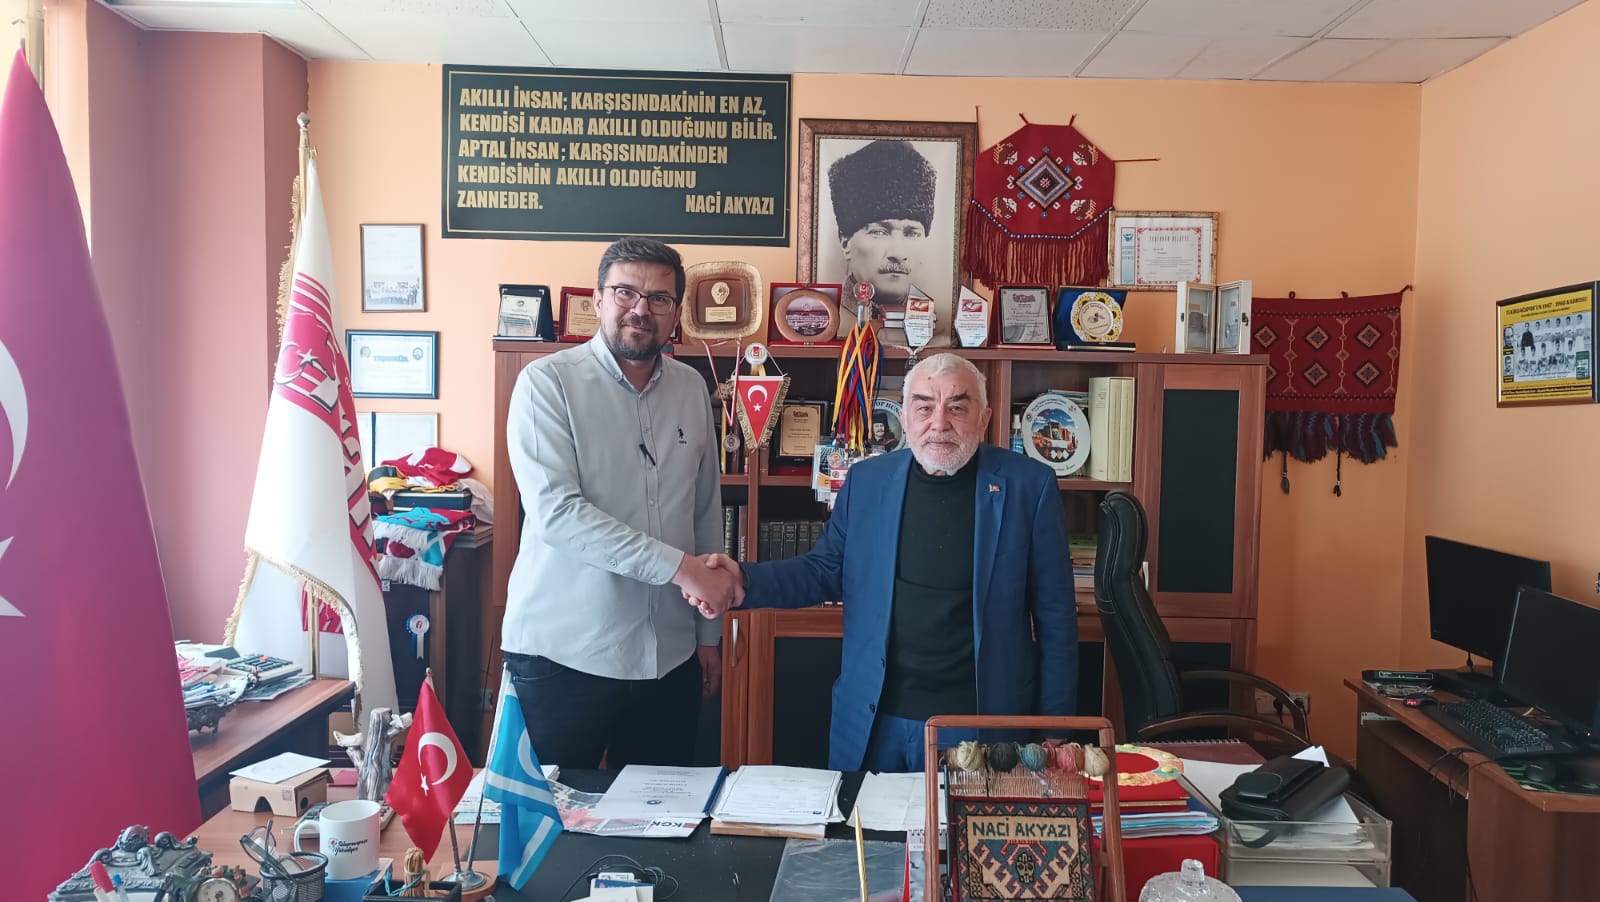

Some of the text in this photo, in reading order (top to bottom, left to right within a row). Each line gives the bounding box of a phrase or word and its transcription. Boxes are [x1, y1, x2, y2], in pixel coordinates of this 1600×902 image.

[458, 85, 767, 116] AKILLI İNSAN; KARŞISINDAKİNİN EN AZ,
[459, 111, 778, 140] KENDİSİ KADAR AKILLI OLDUĞUNU BİLİR.
[457, 137, 508, 160] APTAL
[568, 140, 728, 165] KARŞISINDAKİNDEN
[456, 162, 697, 189] KENDİSİNİN AKILLI OLDUĞUNU
[456, 190, 775, 215] ZANNEDER. NACİ AKYAZI
[972, 817, 1071, 838] NACİ AKYAZI
